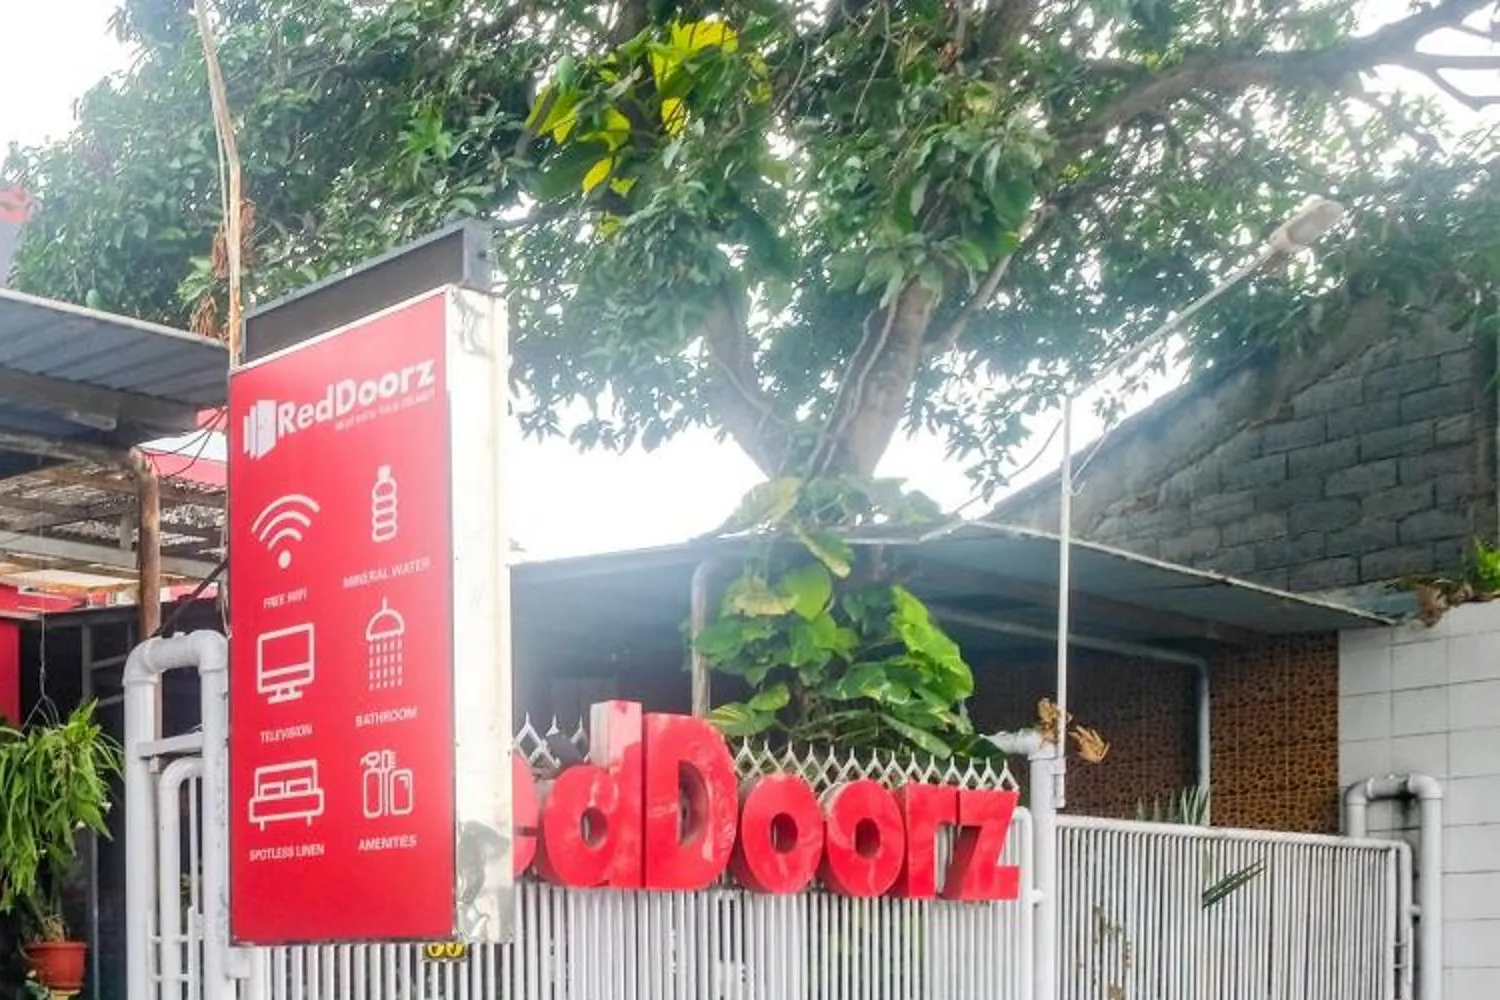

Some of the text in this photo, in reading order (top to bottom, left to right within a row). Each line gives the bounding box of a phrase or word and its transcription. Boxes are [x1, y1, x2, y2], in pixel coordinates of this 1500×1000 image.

[277, 359, 435, 438] RedDoorz
[343, 556, 430, 588] MINERAL WATER
[355, 706, 418, 728] BATHROOM
[260, 723, 313, 743] TELEVISION
[249, 843, 325, 862] SPOTLESS LINEN
[357, 834, 418, 852] AMENITIES
